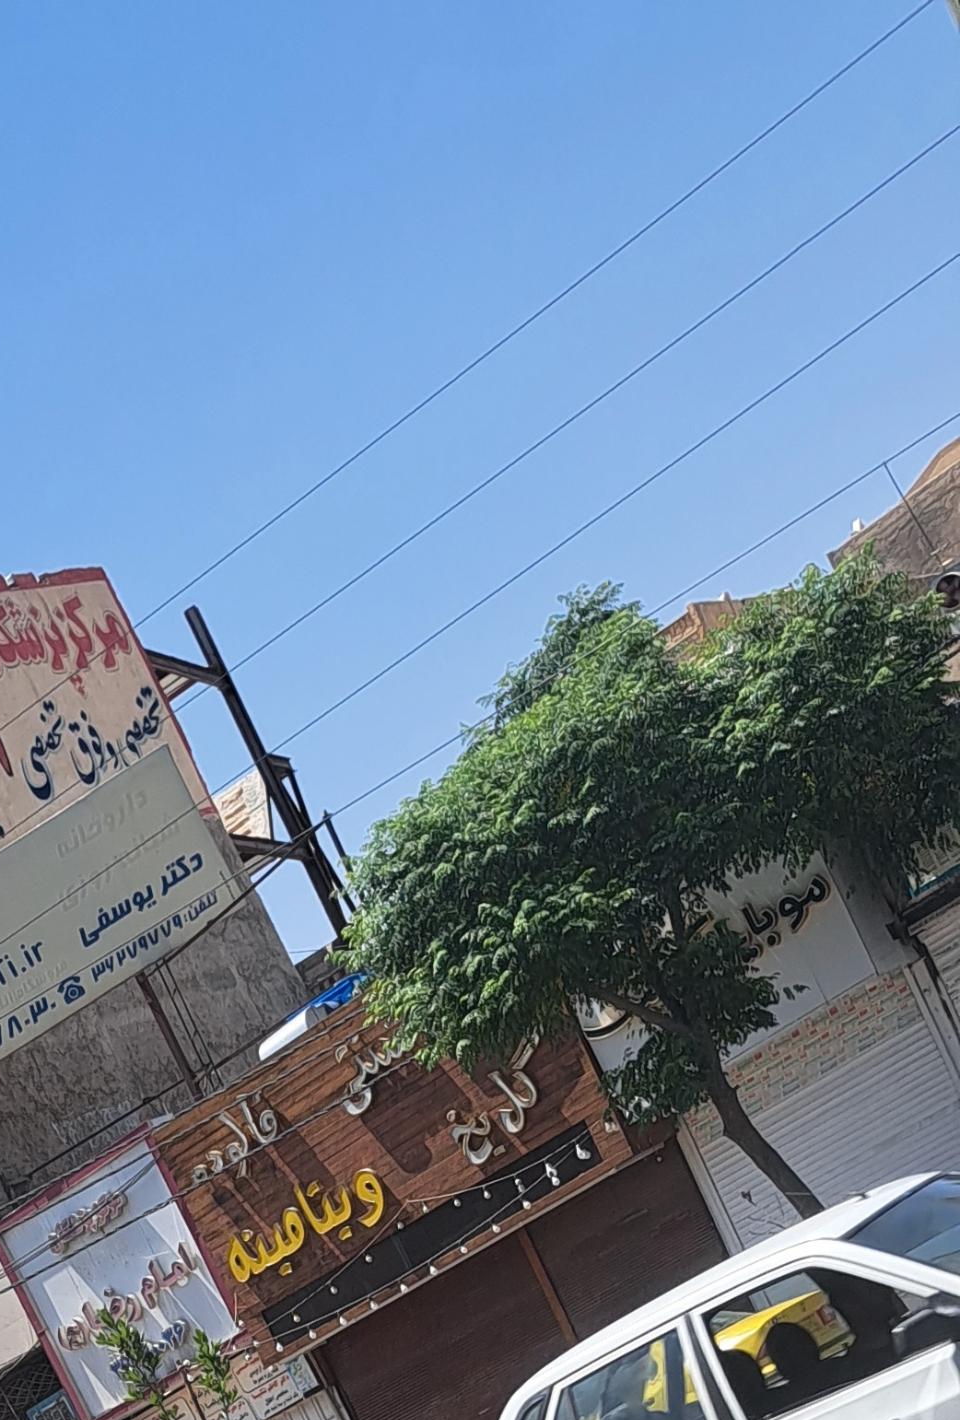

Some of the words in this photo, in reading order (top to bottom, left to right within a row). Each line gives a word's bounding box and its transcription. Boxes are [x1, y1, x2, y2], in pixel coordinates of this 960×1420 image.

[56, 596, 132, 671] مرکز
[161, 852, 204, 897] دکتر
[78, 884, 158, 948] یوسفی
[191, 1092, 279, 1186] فالوده
[228, 1168, 384, 1283] ویتامینه
[141, 1240, 196, 1310] امام
